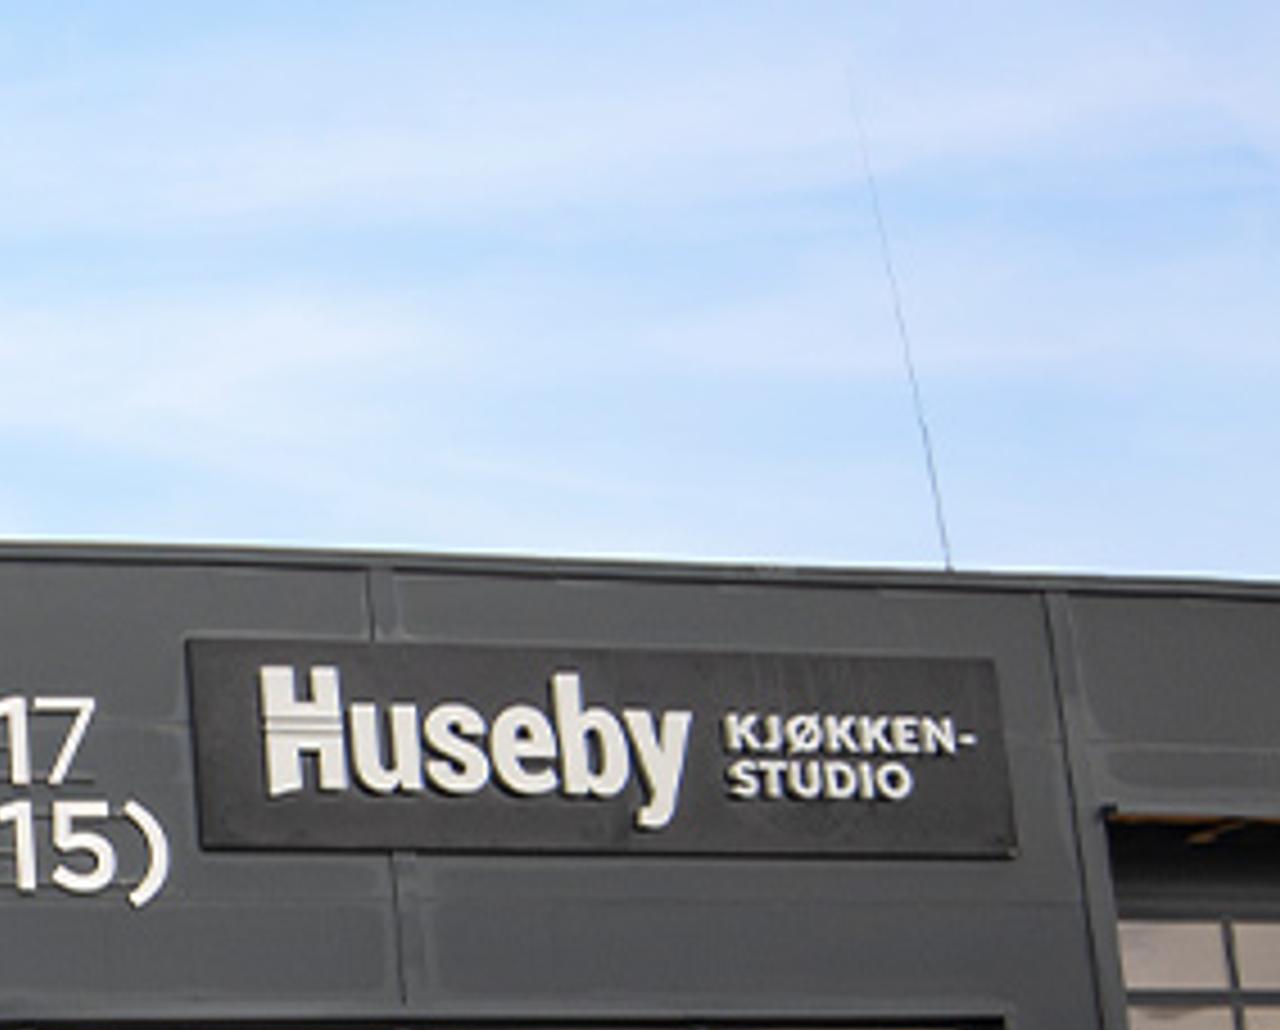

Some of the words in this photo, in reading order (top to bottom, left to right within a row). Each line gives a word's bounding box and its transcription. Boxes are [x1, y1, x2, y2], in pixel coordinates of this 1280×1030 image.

[258, 664, 692, 828] Huseby
[723, 711, 978, 757] KJØKKEN-
[726, 759, 915, 802] STUDIO
